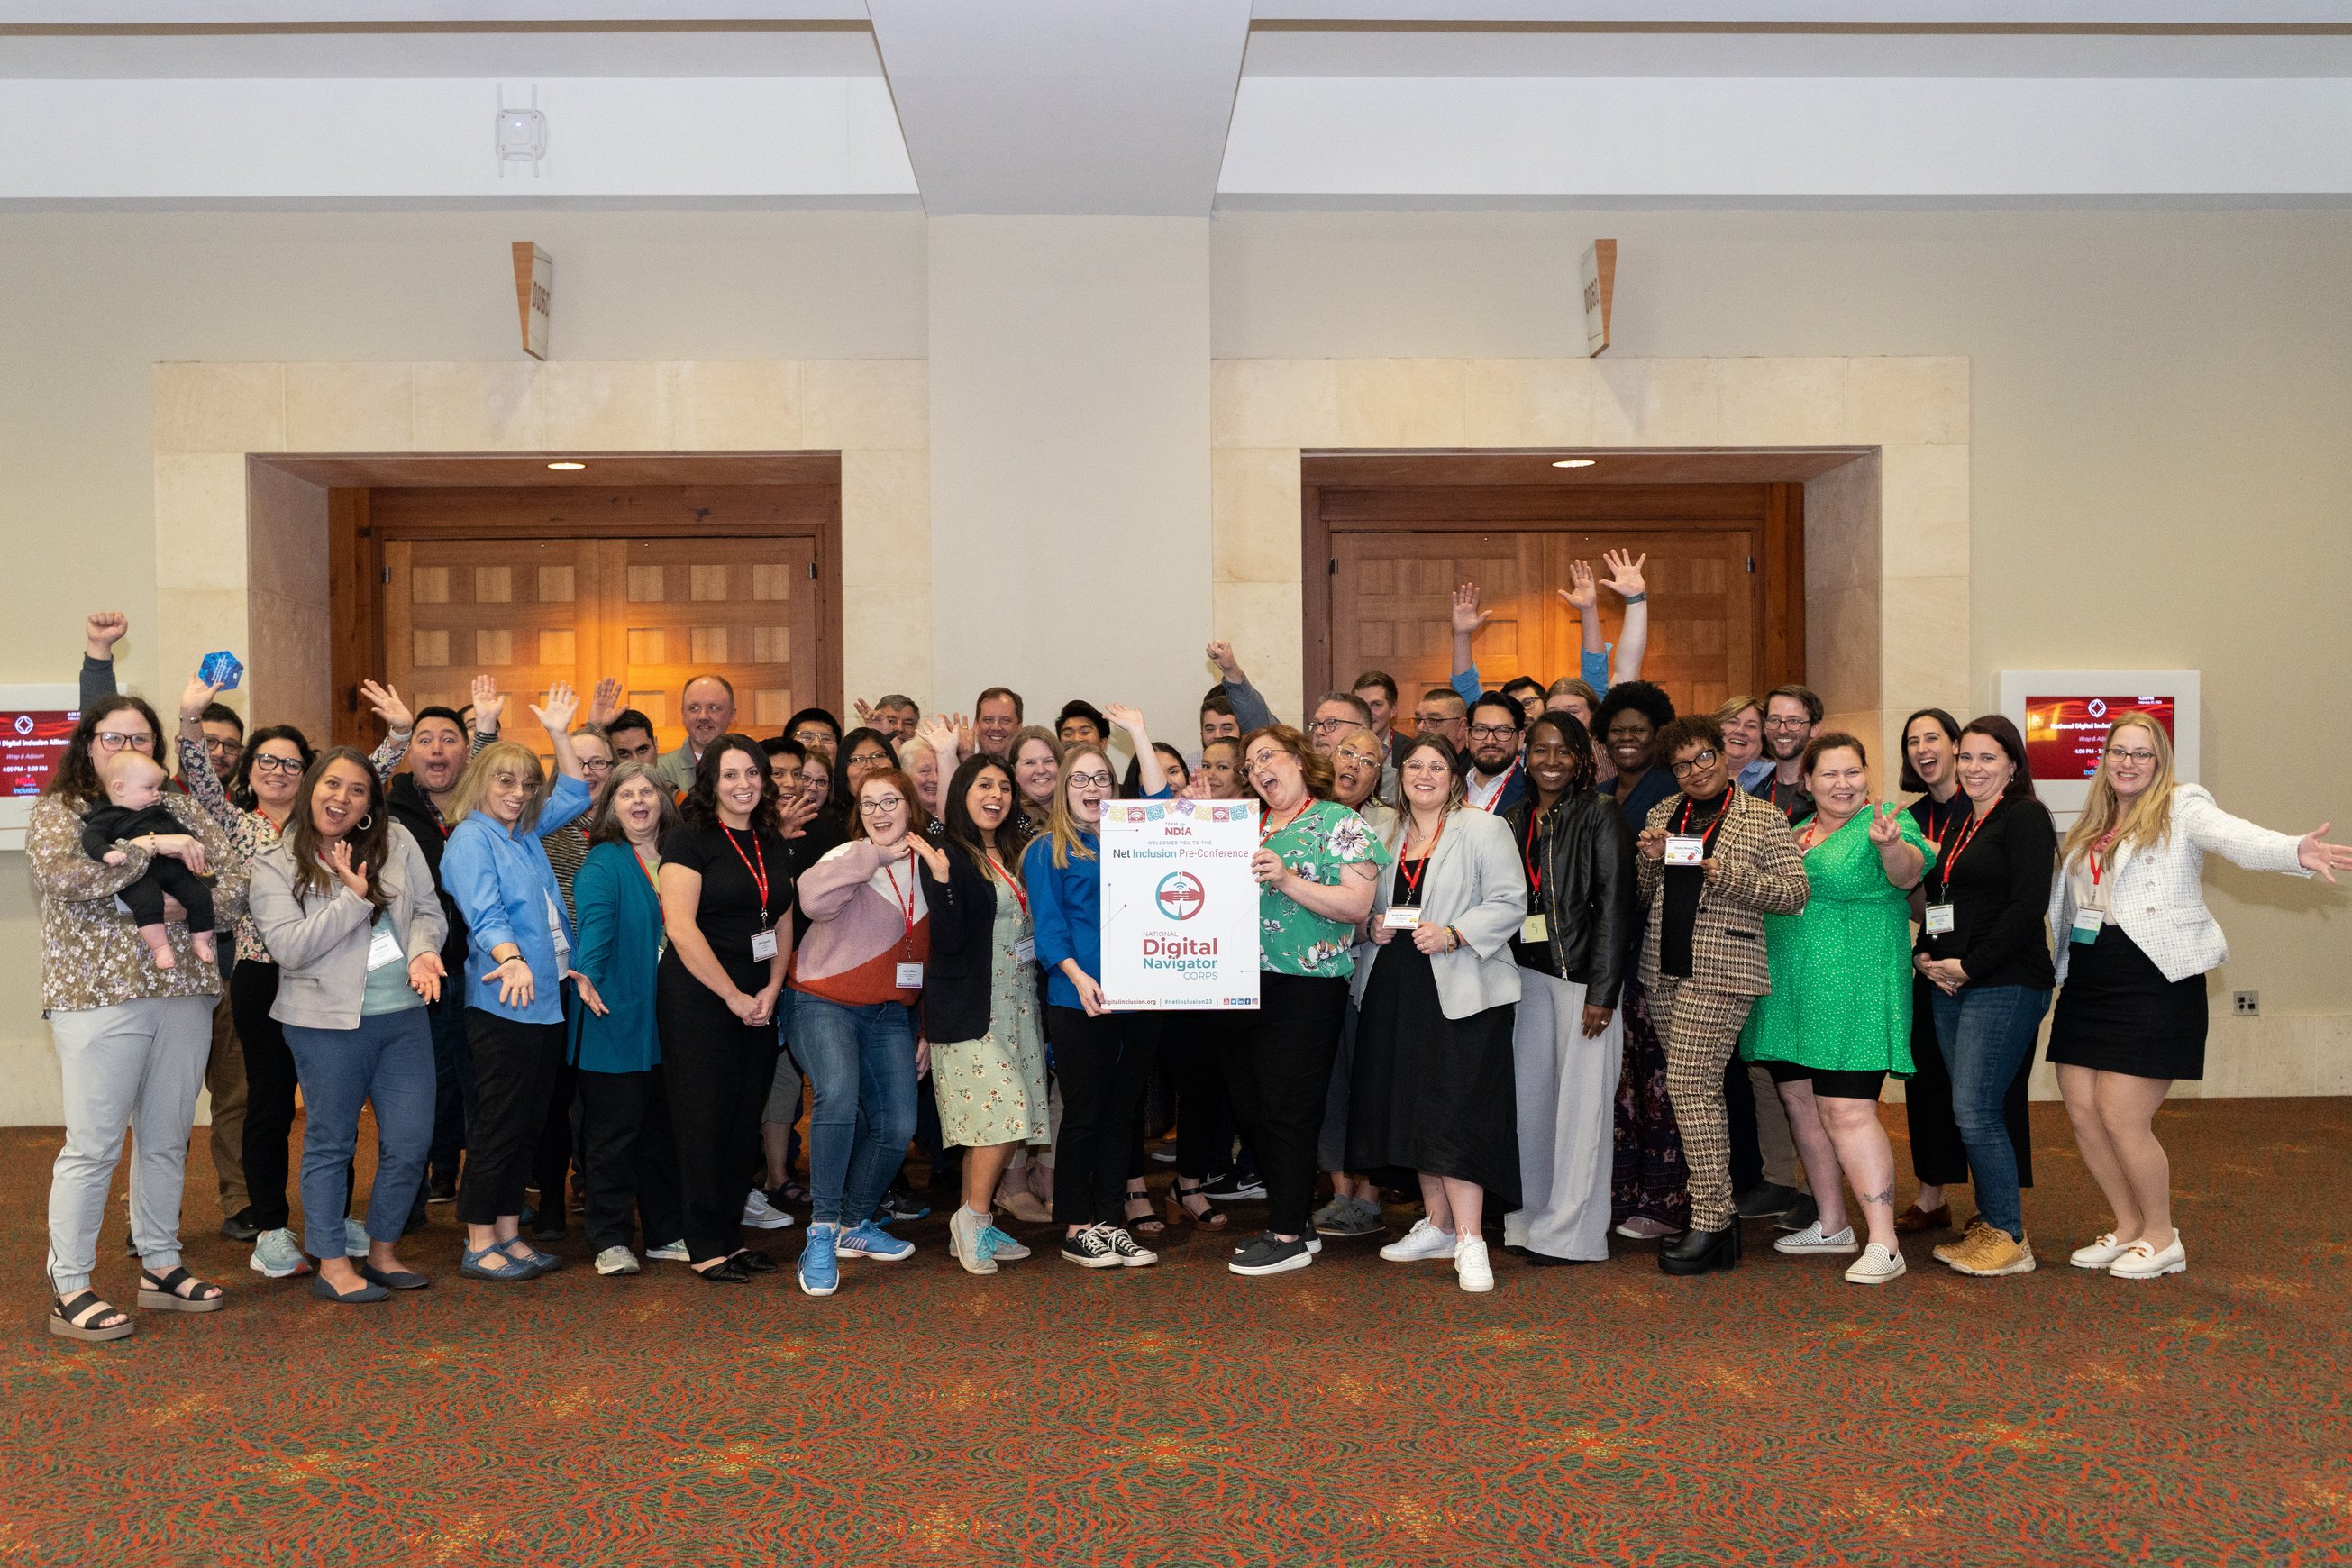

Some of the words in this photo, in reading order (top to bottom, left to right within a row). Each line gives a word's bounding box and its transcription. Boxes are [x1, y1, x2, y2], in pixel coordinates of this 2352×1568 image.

[2074, 723, 2093, 731] Digital
[2, 740, 22, 748] Digital
[1164, 826, 1192, 836] NDIA
[1113, 849, 1131, 859] Net
[1133, 848, 1177, 859] Inclusion
[1179, 848, 1249, 859] Pre-Conference
[1531, 922, 1538, 935] 5
[1143, 937, 1217, 959] Digital
[1143, 957, 1217, 971] Navigator
[1183, 971, 1218, 980] CORPS
